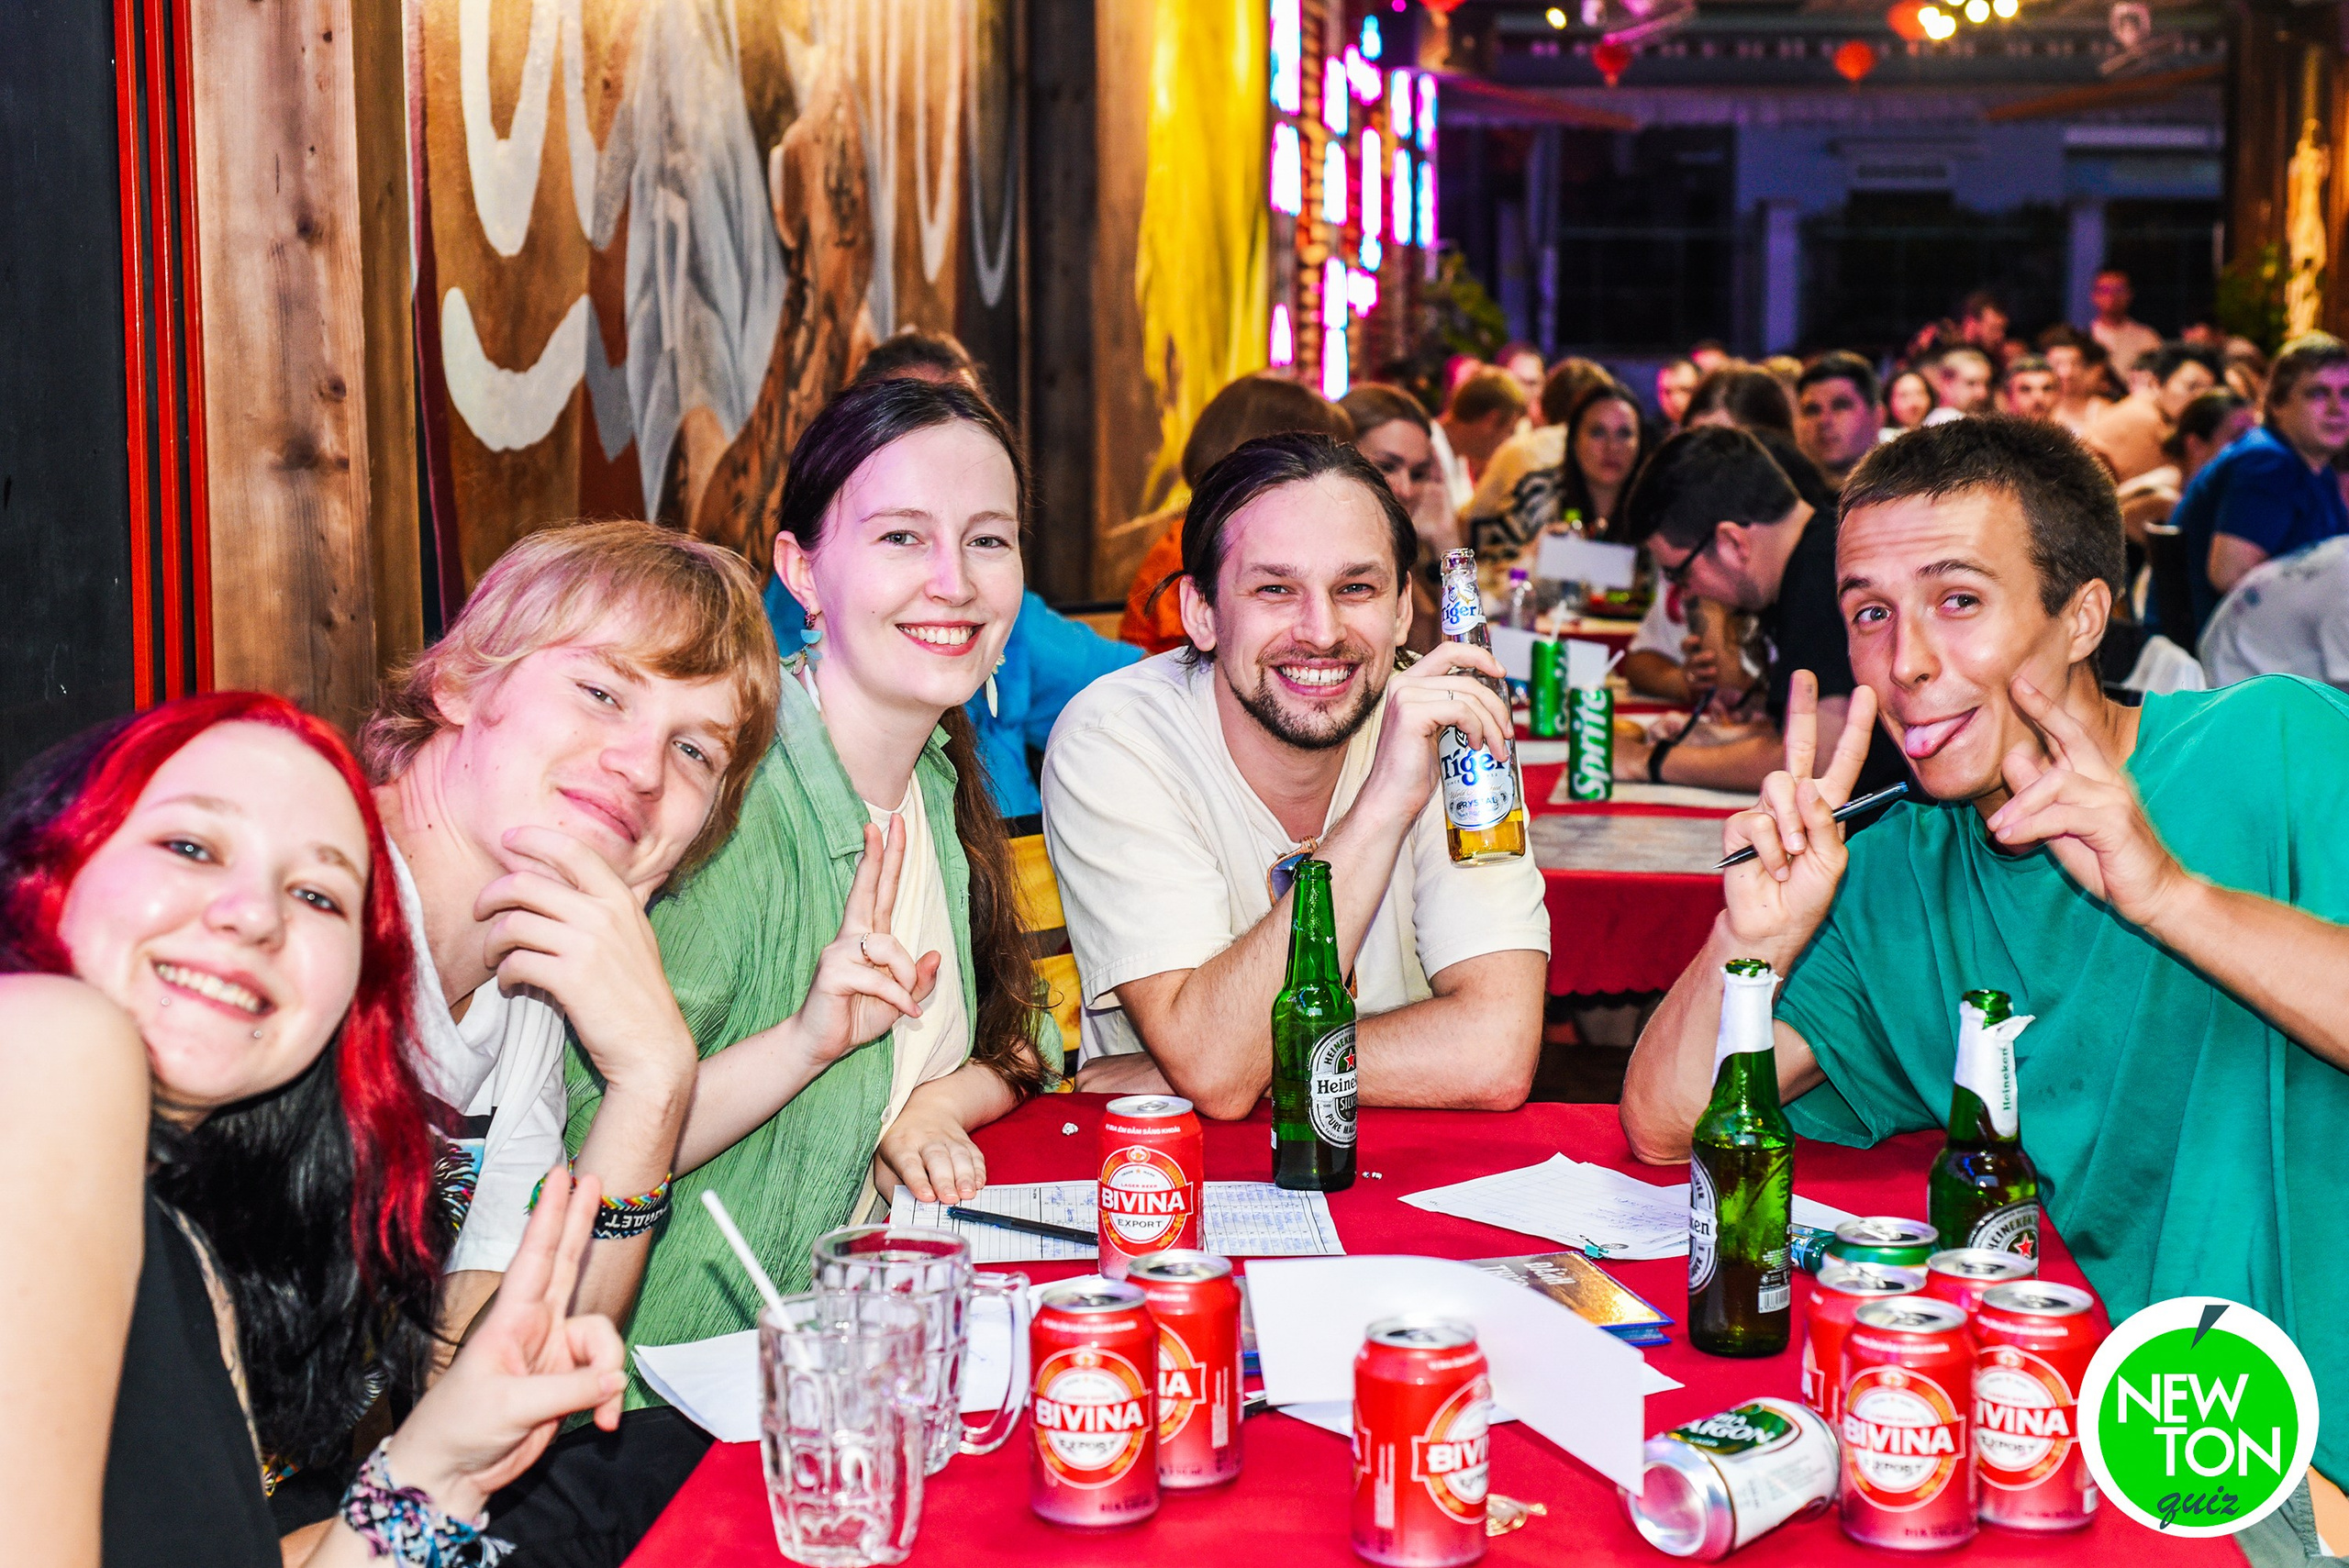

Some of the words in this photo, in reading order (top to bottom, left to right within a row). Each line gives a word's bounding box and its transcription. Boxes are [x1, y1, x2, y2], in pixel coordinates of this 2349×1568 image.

[1574, 689, 1610, 799] Sprite
[1455, 795, 1497, 810] CRYSAL
[1324, 1034, 1356, 1065] HEINEKE
[1317, 1074, 1356, 1095] Heine
[2003, 1048, 2012, 1111] Heineken
[1325, 1113, 1341, 1132] PURE
[1101, 1186, 1186, 1213] BIVINA
[1118, 1218, 1163, 1228] EXPORT
[1035, 1397, 1144, 1431] BIVINA
[1976, 1400, 2069, 1437] IVINA
[1683, 1419, 1776, 1445] AIGON
[1843, 1414, 1955, 1455] BIVINA
[1980, 1437, 2036, 1453] EXPORT
[1059, 1439, 1116, 1453] EXPORT
[1426, 1435, 1489, 1473] BIVI
